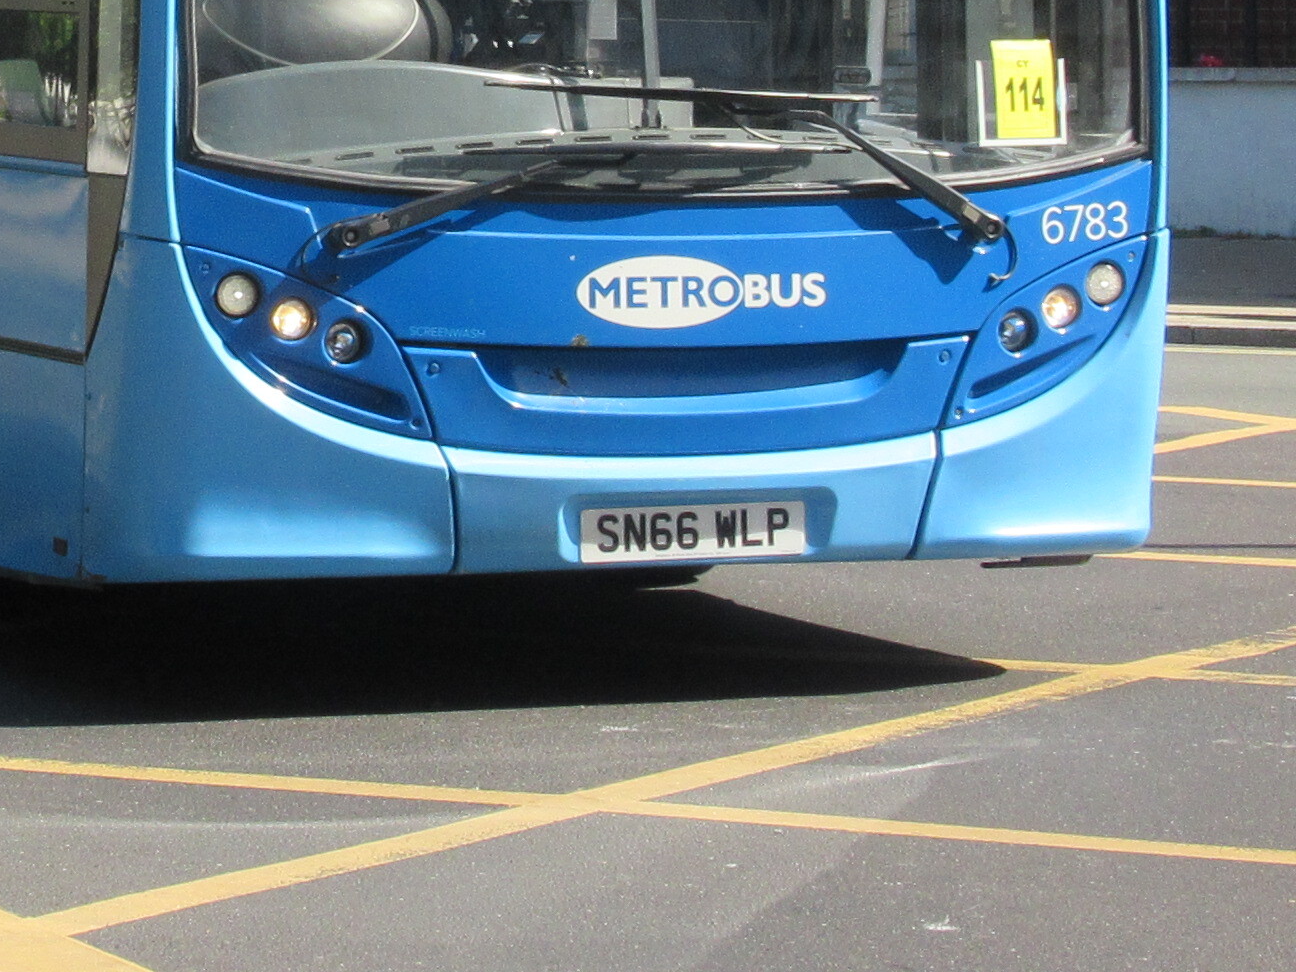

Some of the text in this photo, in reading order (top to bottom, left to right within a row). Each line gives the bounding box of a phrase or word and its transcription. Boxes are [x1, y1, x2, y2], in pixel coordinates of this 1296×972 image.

[1005, 77, 1044, 112] 114
[1041, 200, 1129, 245] 6783
[587, 272, 827, 310] METROBUS
[409, 326, 486, 339] SCREENWASH
[597, 507, 790, 554] SN66 WLP
